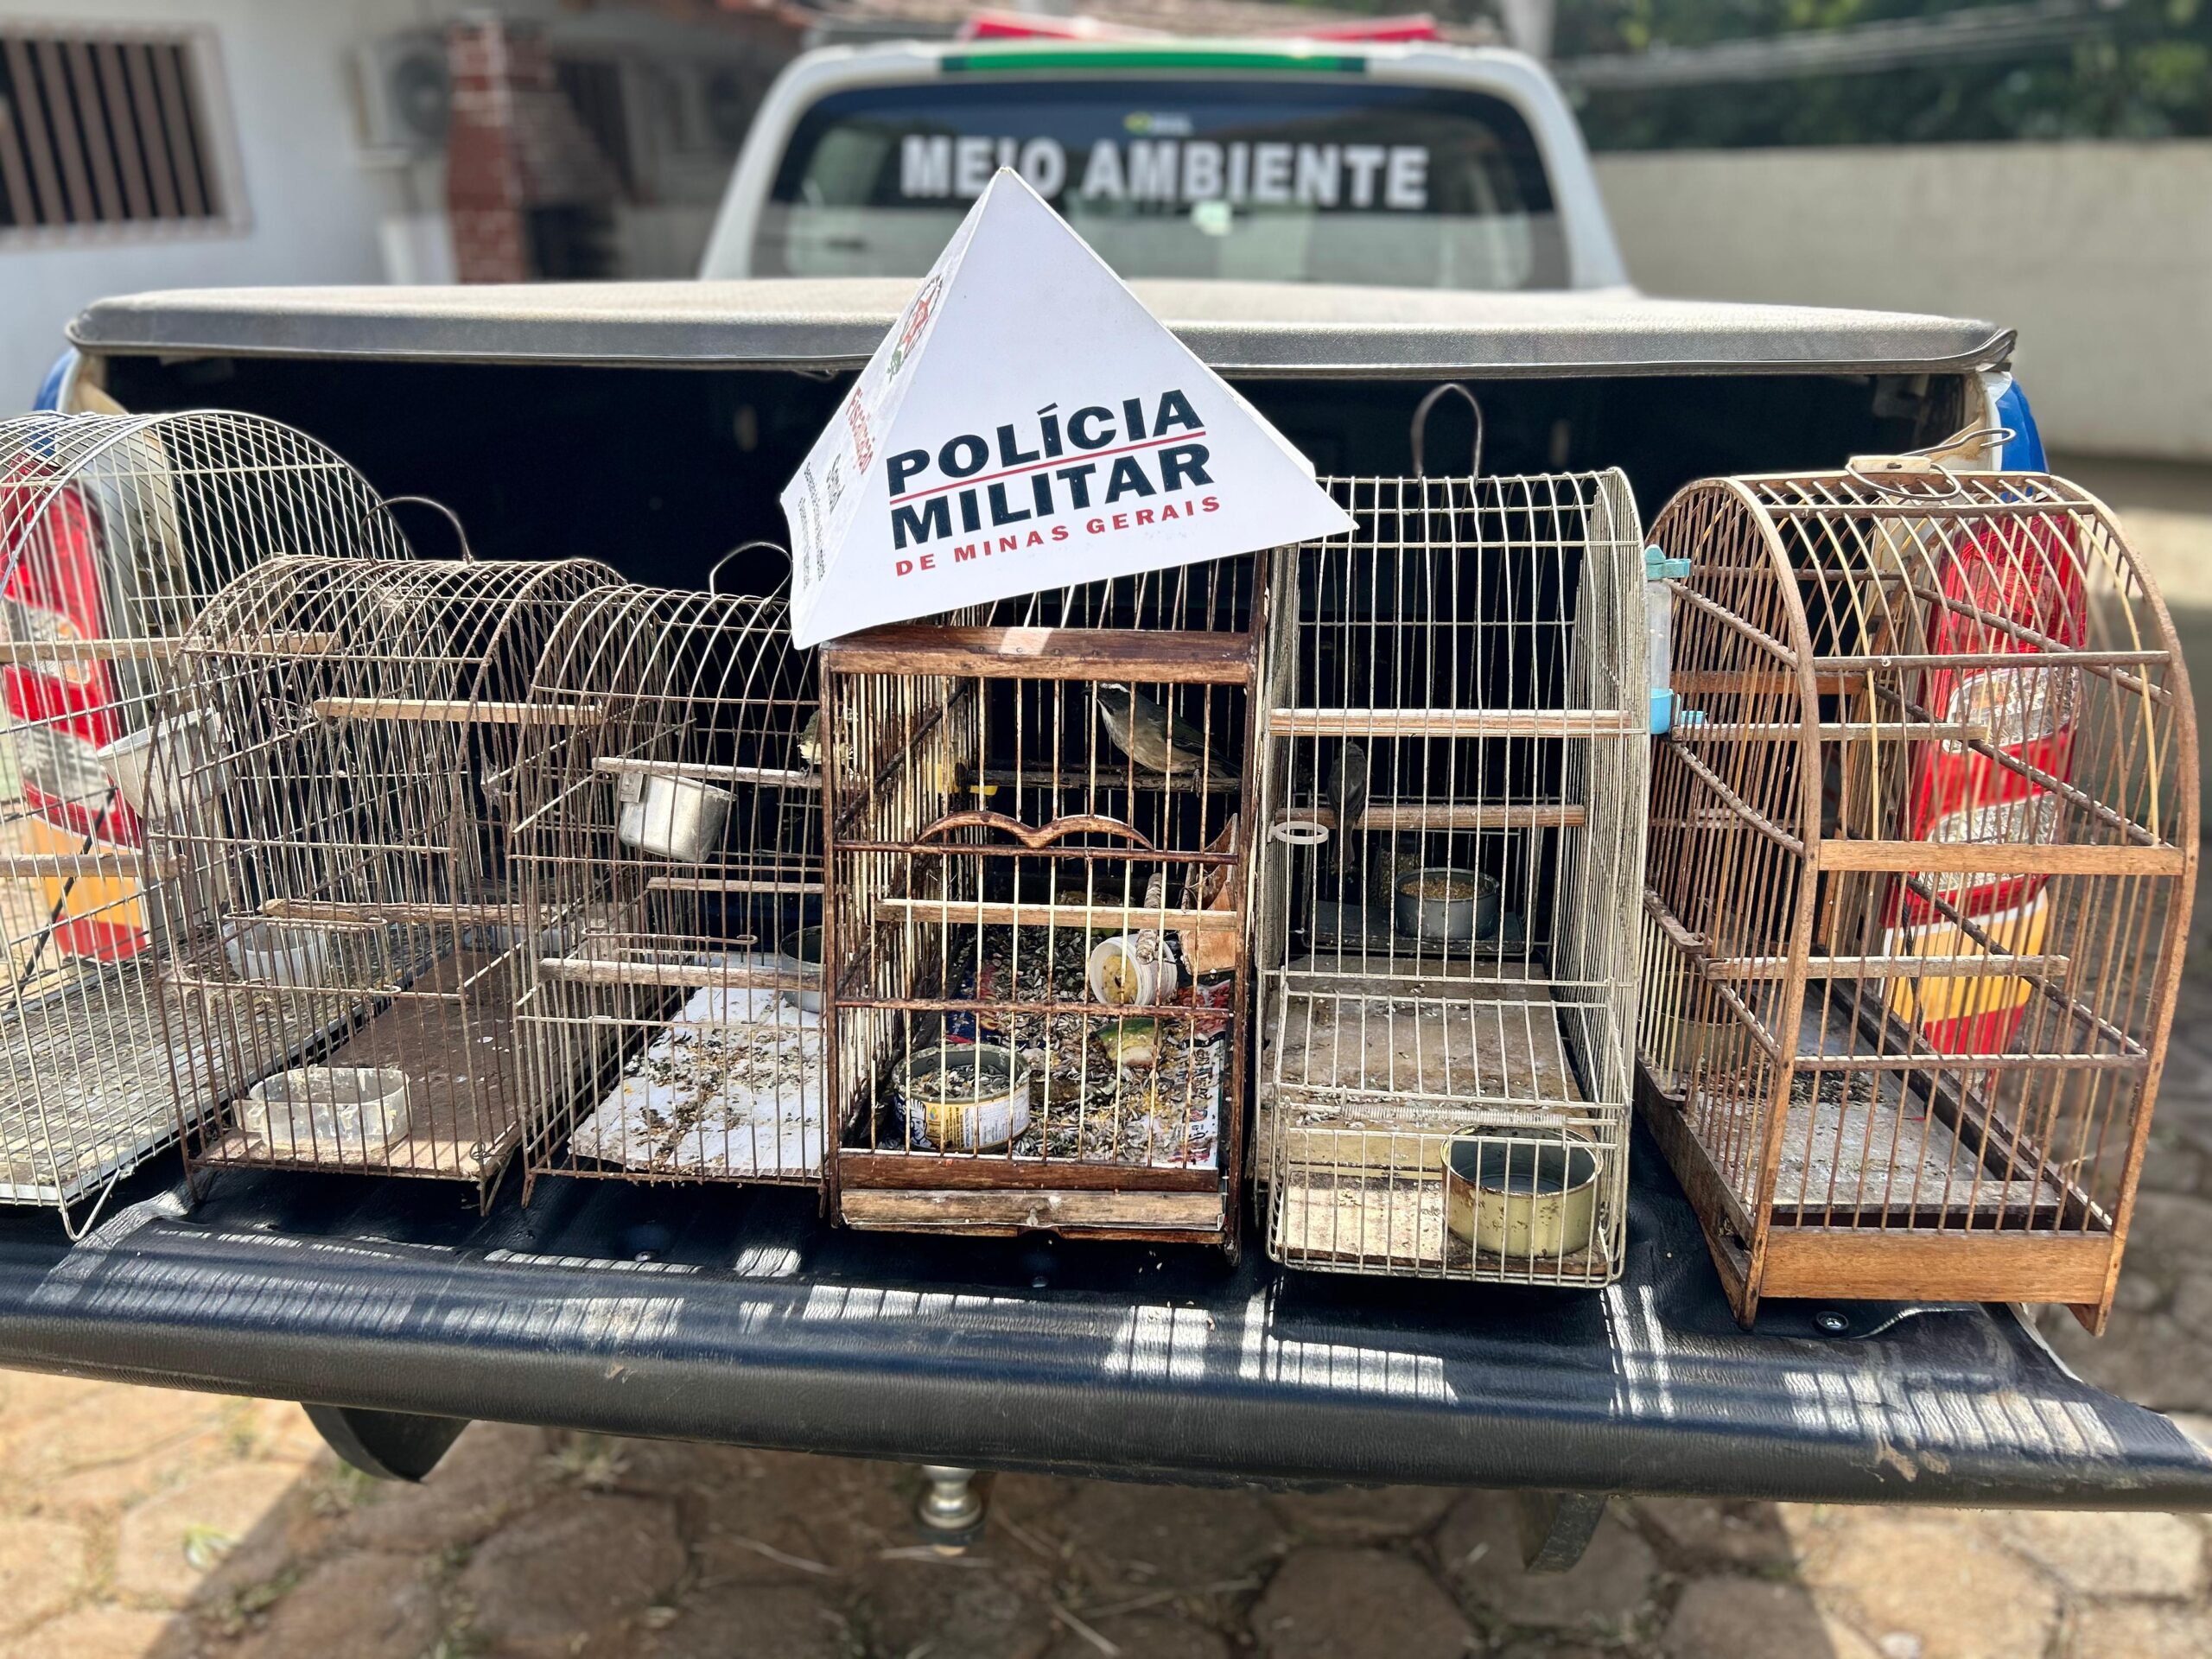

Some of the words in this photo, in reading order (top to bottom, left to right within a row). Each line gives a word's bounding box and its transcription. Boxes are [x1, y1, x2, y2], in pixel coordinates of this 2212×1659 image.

[1081, 138, 1429, 209] AMBIENTE
[887, 389, 1205, 497] POLÍCIA
[891, 443, 1214, 550] MILITAR
[895, 554, 936, 576] DE
[954, 525, 1069, 563] MINAS
[1086, 496, 1221, 535] GERAIS
